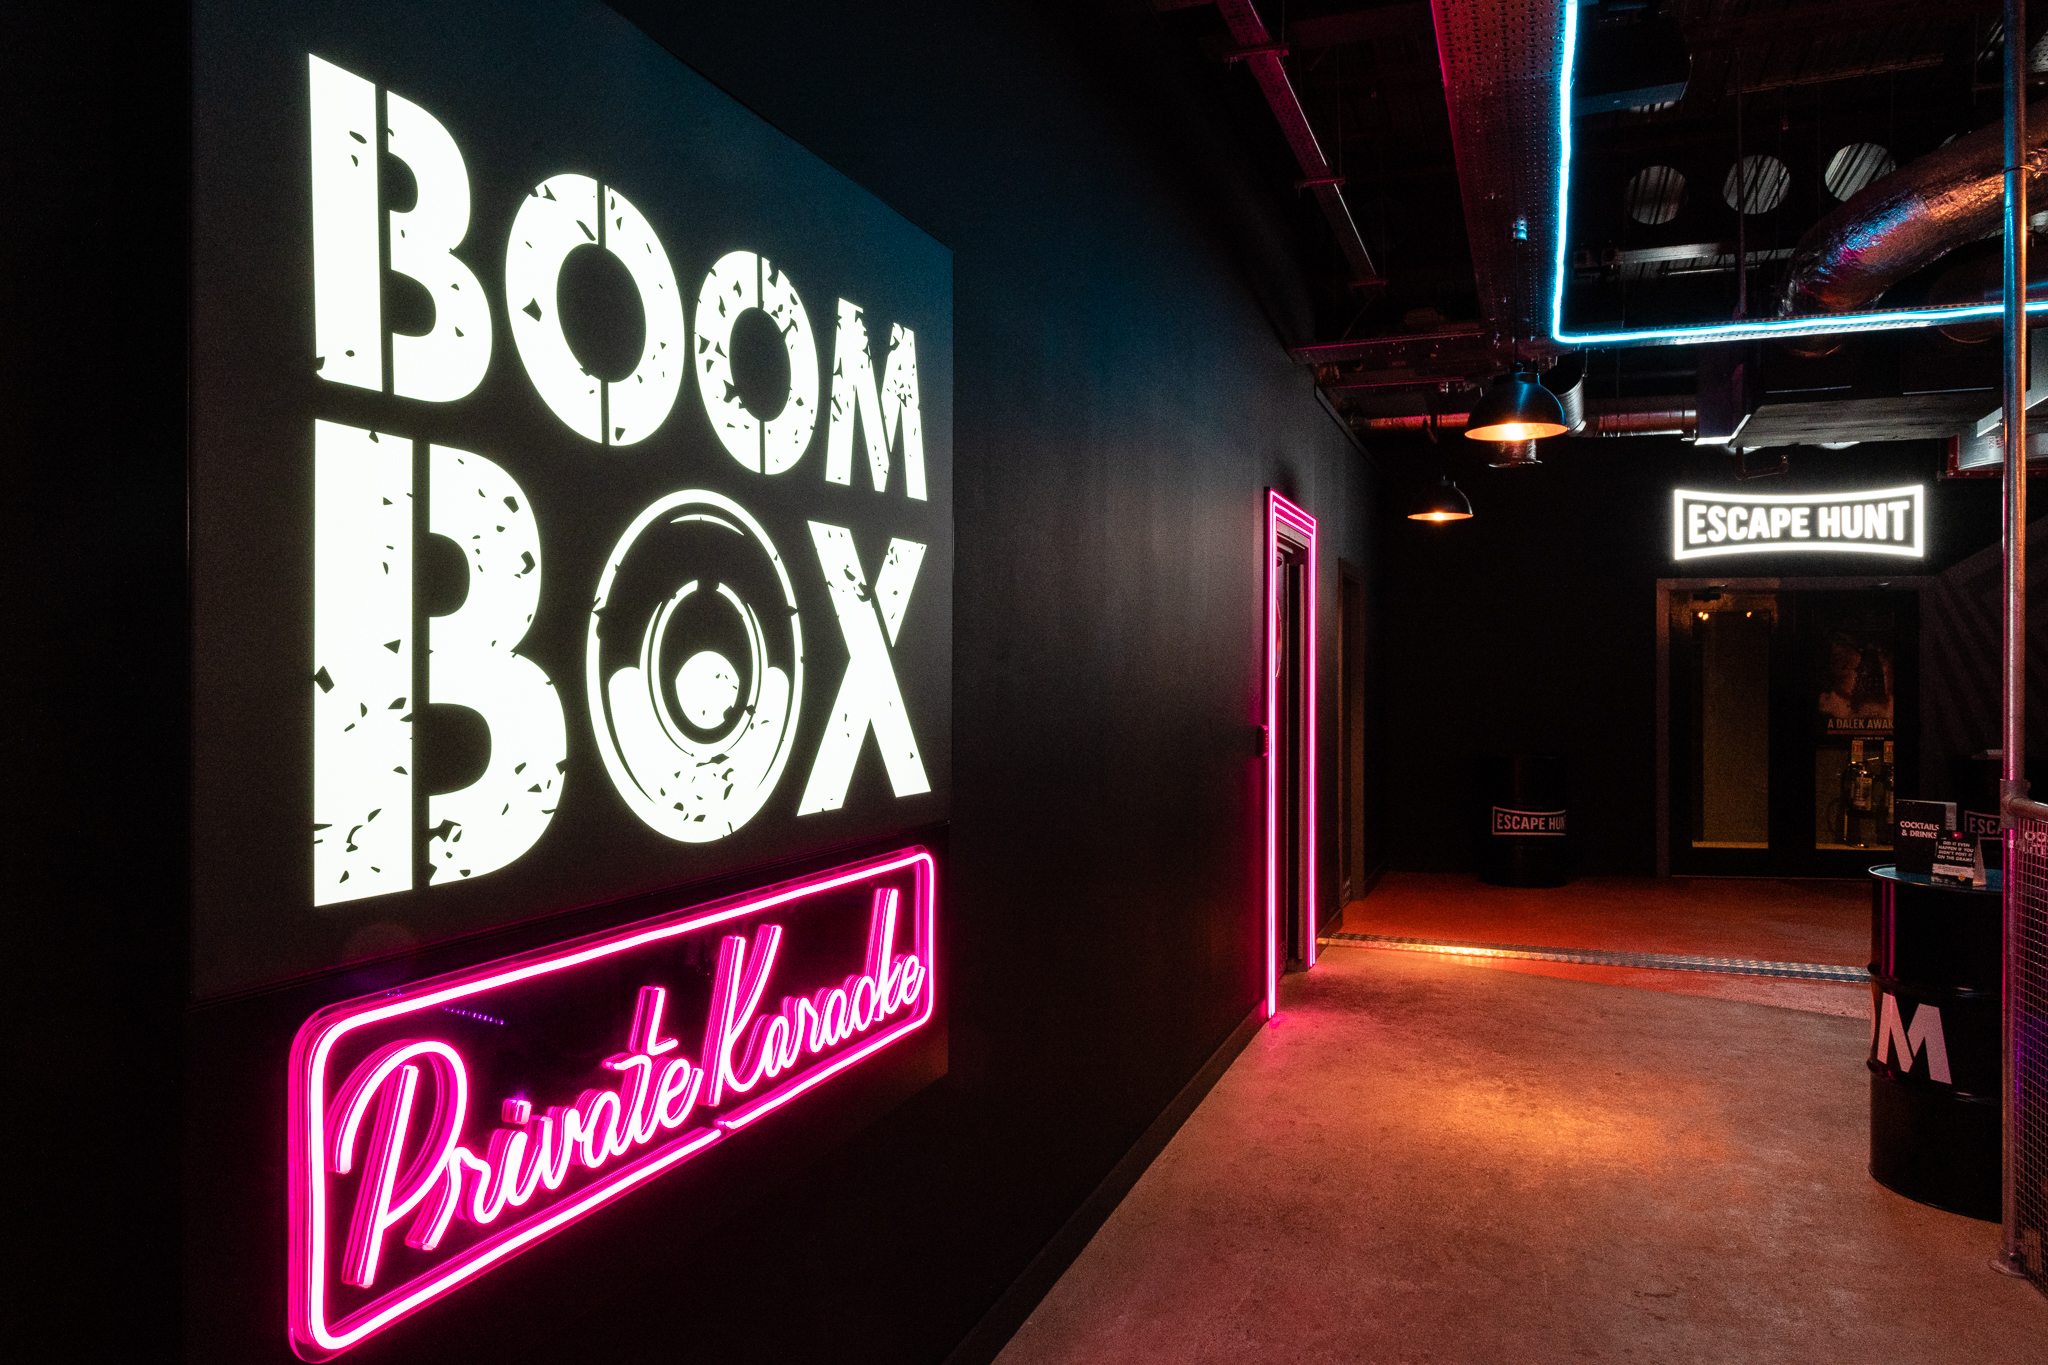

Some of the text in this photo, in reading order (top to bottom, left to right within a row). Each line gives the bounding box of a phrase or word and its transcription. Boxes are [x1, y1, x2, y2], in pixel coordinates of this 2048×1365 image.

[309, 53, 928, 502] BOOM
[1688, 501, 1910, 544] ESCAPE HUNT
[314, 418, 932, 907] BOX
[1827, 718, 1834, 729] A
[1836, 719, 1865, 729] DALEK
[1496, 812, 1566, 831] ESCAPE HUN
[1900, 820, 1940, 831] COCKTAILS
[1901, 829, 1937, 839] & DRINKS
[330, 887, 925, 1288] Private Karaoke
